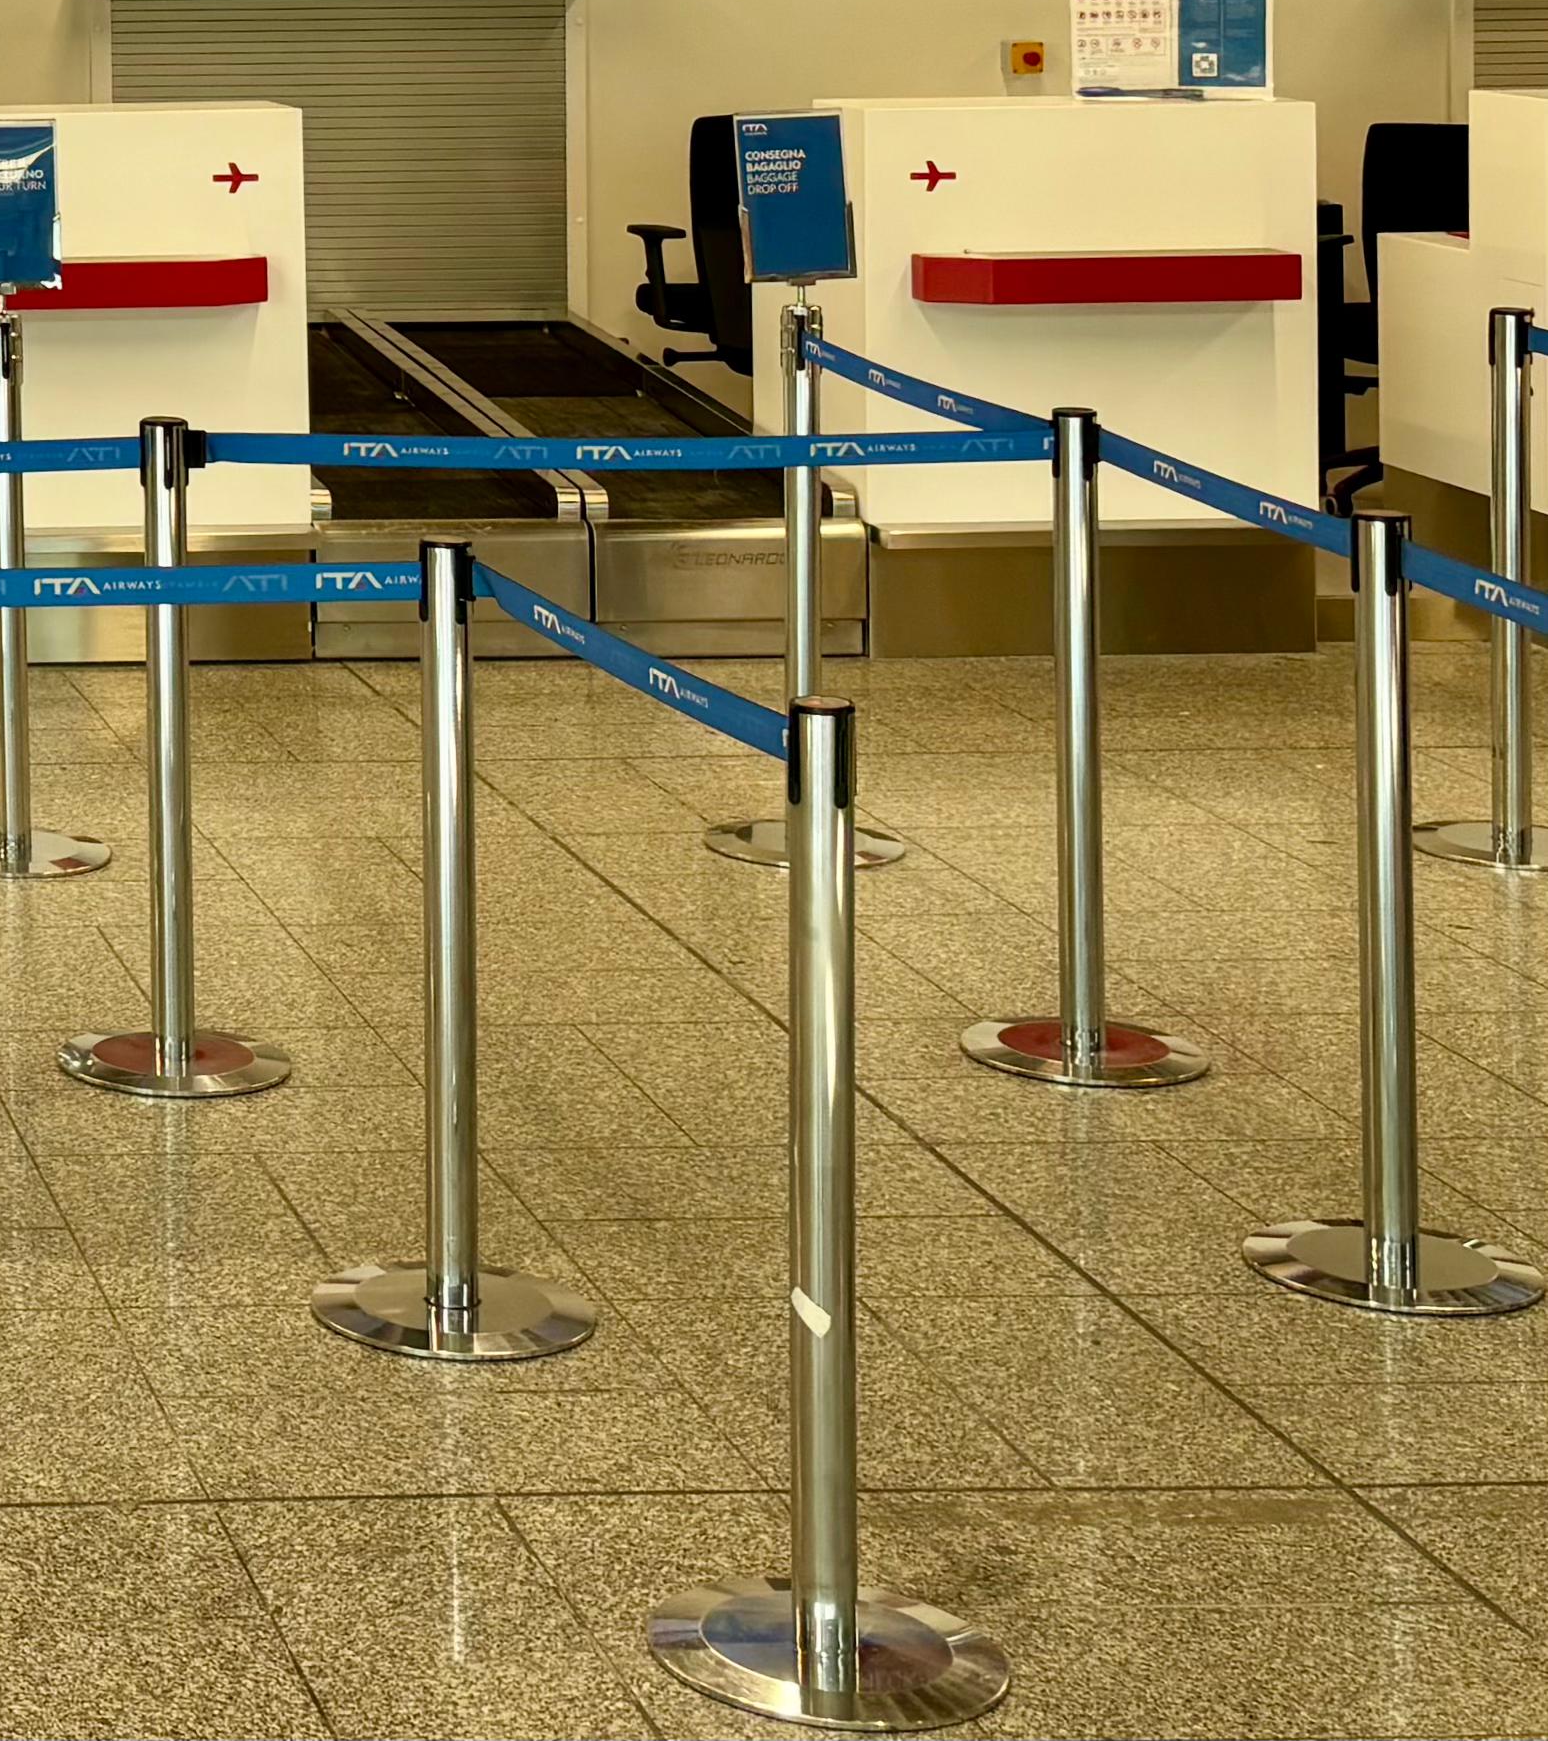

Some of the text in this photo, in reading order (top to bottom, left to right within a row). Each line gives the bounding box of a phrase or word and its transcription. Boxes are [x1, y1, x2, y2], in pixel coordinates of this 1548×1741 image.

[745, 149, 806, 161] CONSEGNA
[746, 160, 801, 172] BAGAGLIO
[747, 171, 797, 183] BAGGAGE
[748, 183, 797, 195] DROP OFF
